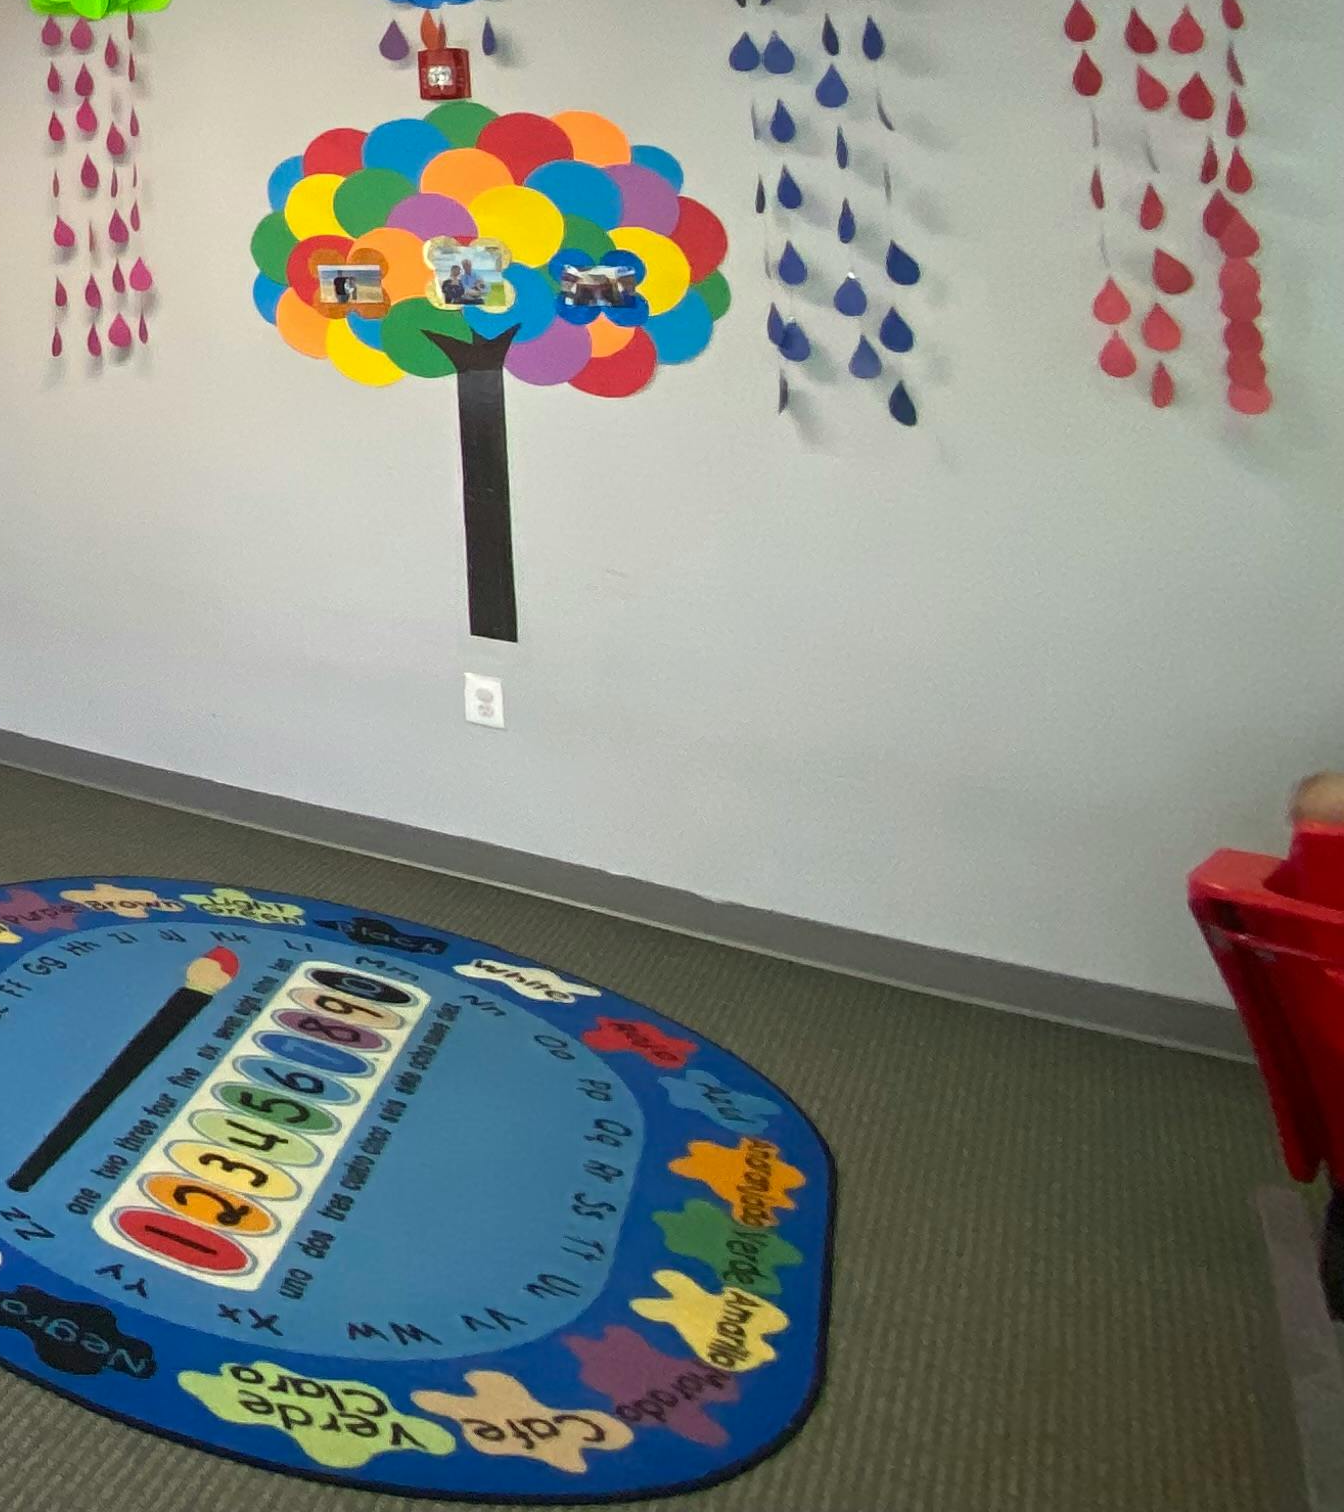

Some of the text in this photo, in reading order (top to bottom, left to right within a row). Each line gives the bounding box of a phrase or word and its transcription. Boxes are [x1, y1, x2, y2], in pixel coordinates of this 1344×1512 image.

[2, 902, 84, 924] Purple
[85, 899, 180, 912] Brown
[58, 939, 101, 957] Hh
[23, 956, 67, 976] Gg
[355, 956, 419, 982] Mm
[475, 960, 570, 1000] White
[460, 994, 507, 1016] Nn
[534, 1035, 576, 1061] Oo
[575, 1078, 612, 1102] Pp
[144, 976, 384, 1255] 1 2 3 4 5 6 7 8 9 0
[66, 1187, 102, 1216] one
[90, 1153, 129, 1180] two
[113, 1118, 159, 1153] three
[141, 1092, 179, 1118] four
[165, 1067, 202, 1089] five
[583, 1118, 632, 1147] Qq
[582, 1158, 624, 1183] Rr
[316, 1192, 355, 1222] tres
[571, 1192, 617, 1220] Ss
[296, 1229, 337, 1259] dos
[561, 1235, 605, 1261] Tt
[723, 1231, 769, 1284] Verde
[95, 1263, 148, 1299] Yy
[278, 1267, 313, 1300] uno
[523, 1273, 581, 1298] Uu
[217, 1302, 283, 1337] Xx
[347, 1321, 442, 1345] Ww
[460, 1307, 528, 1333] Vv
[709, 1290, 761, 1369] Amarillo
[1, 1299, 148, 1374] Negro
[230, 1365, 388, 1418] Claro
[616, 1365, 733, 1422] Morado
[237, 1389, 429, 1450] Verde
